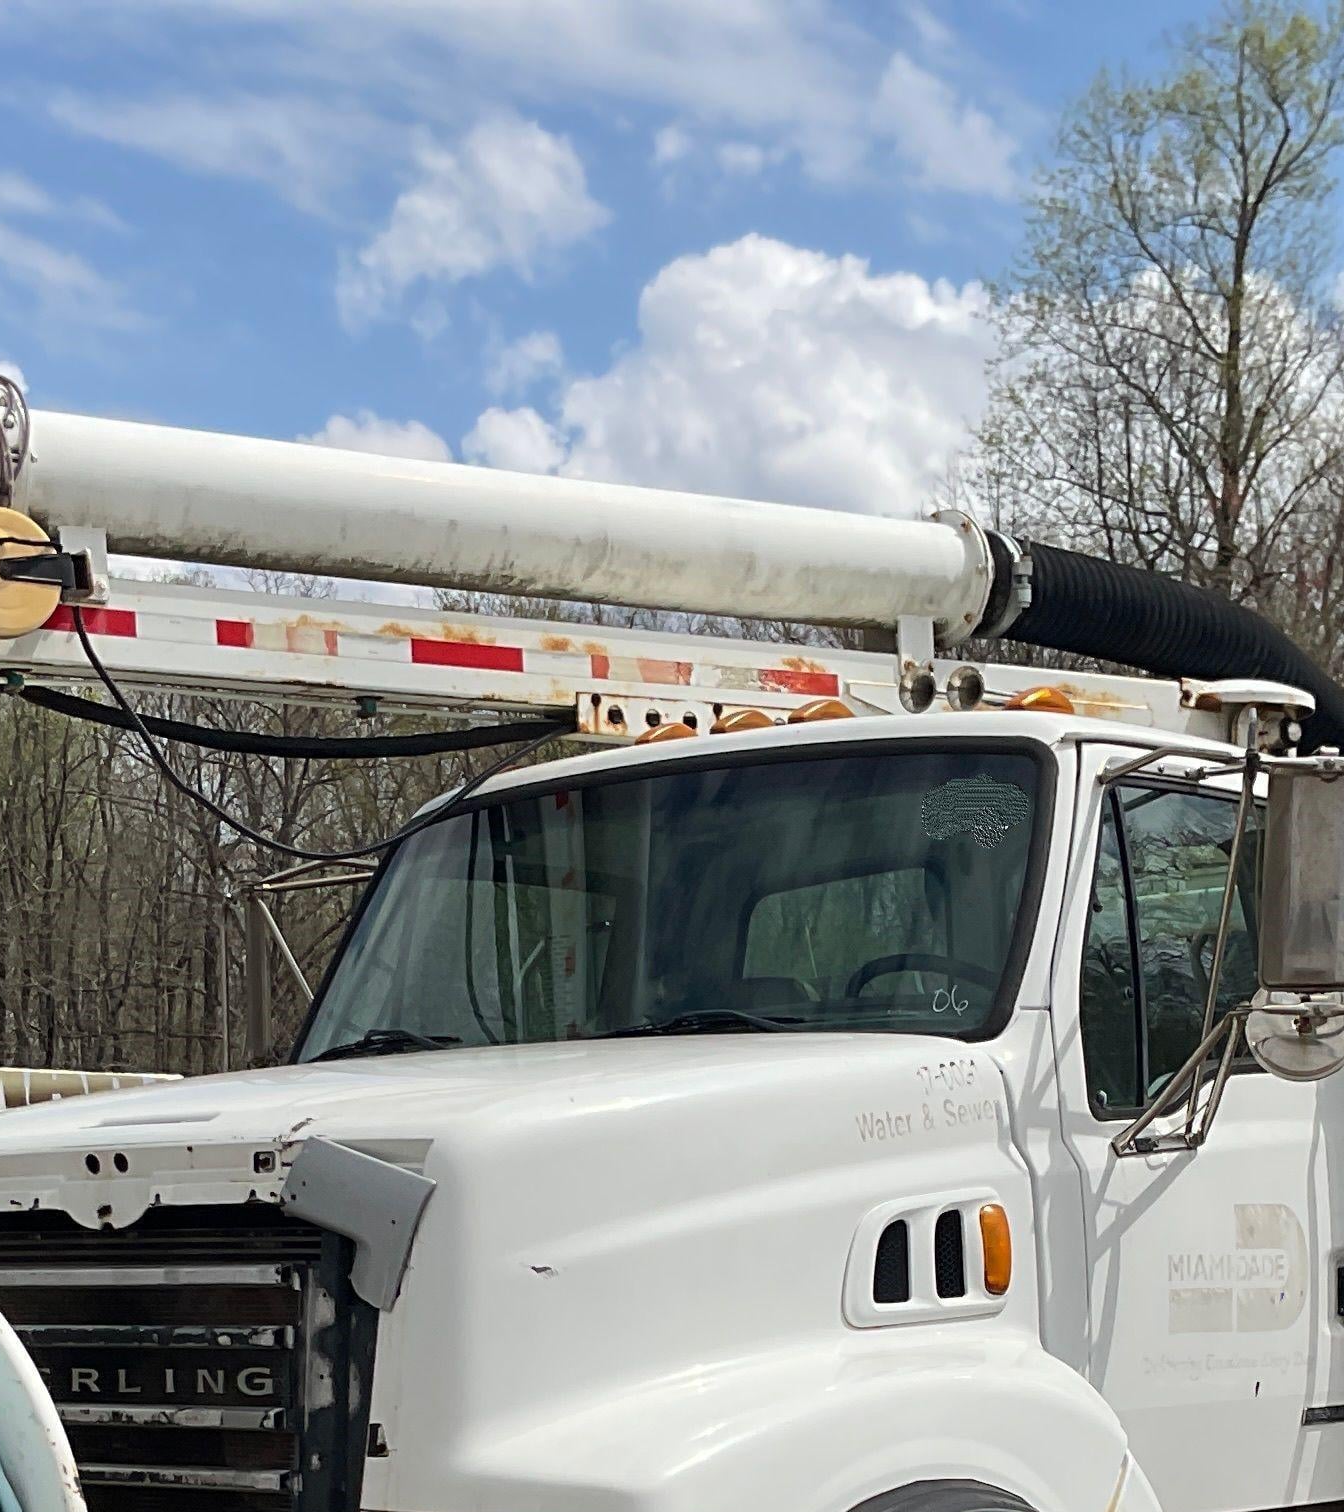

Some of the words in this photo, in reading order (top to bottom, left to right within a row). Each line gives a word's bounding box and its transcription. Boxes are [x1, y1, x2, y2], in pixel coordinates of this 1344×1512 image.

[932, 984, 969, 1016] 06
[855, 1111, 912, 1143] Water
[41, 1366, 274, 1396] RLING
